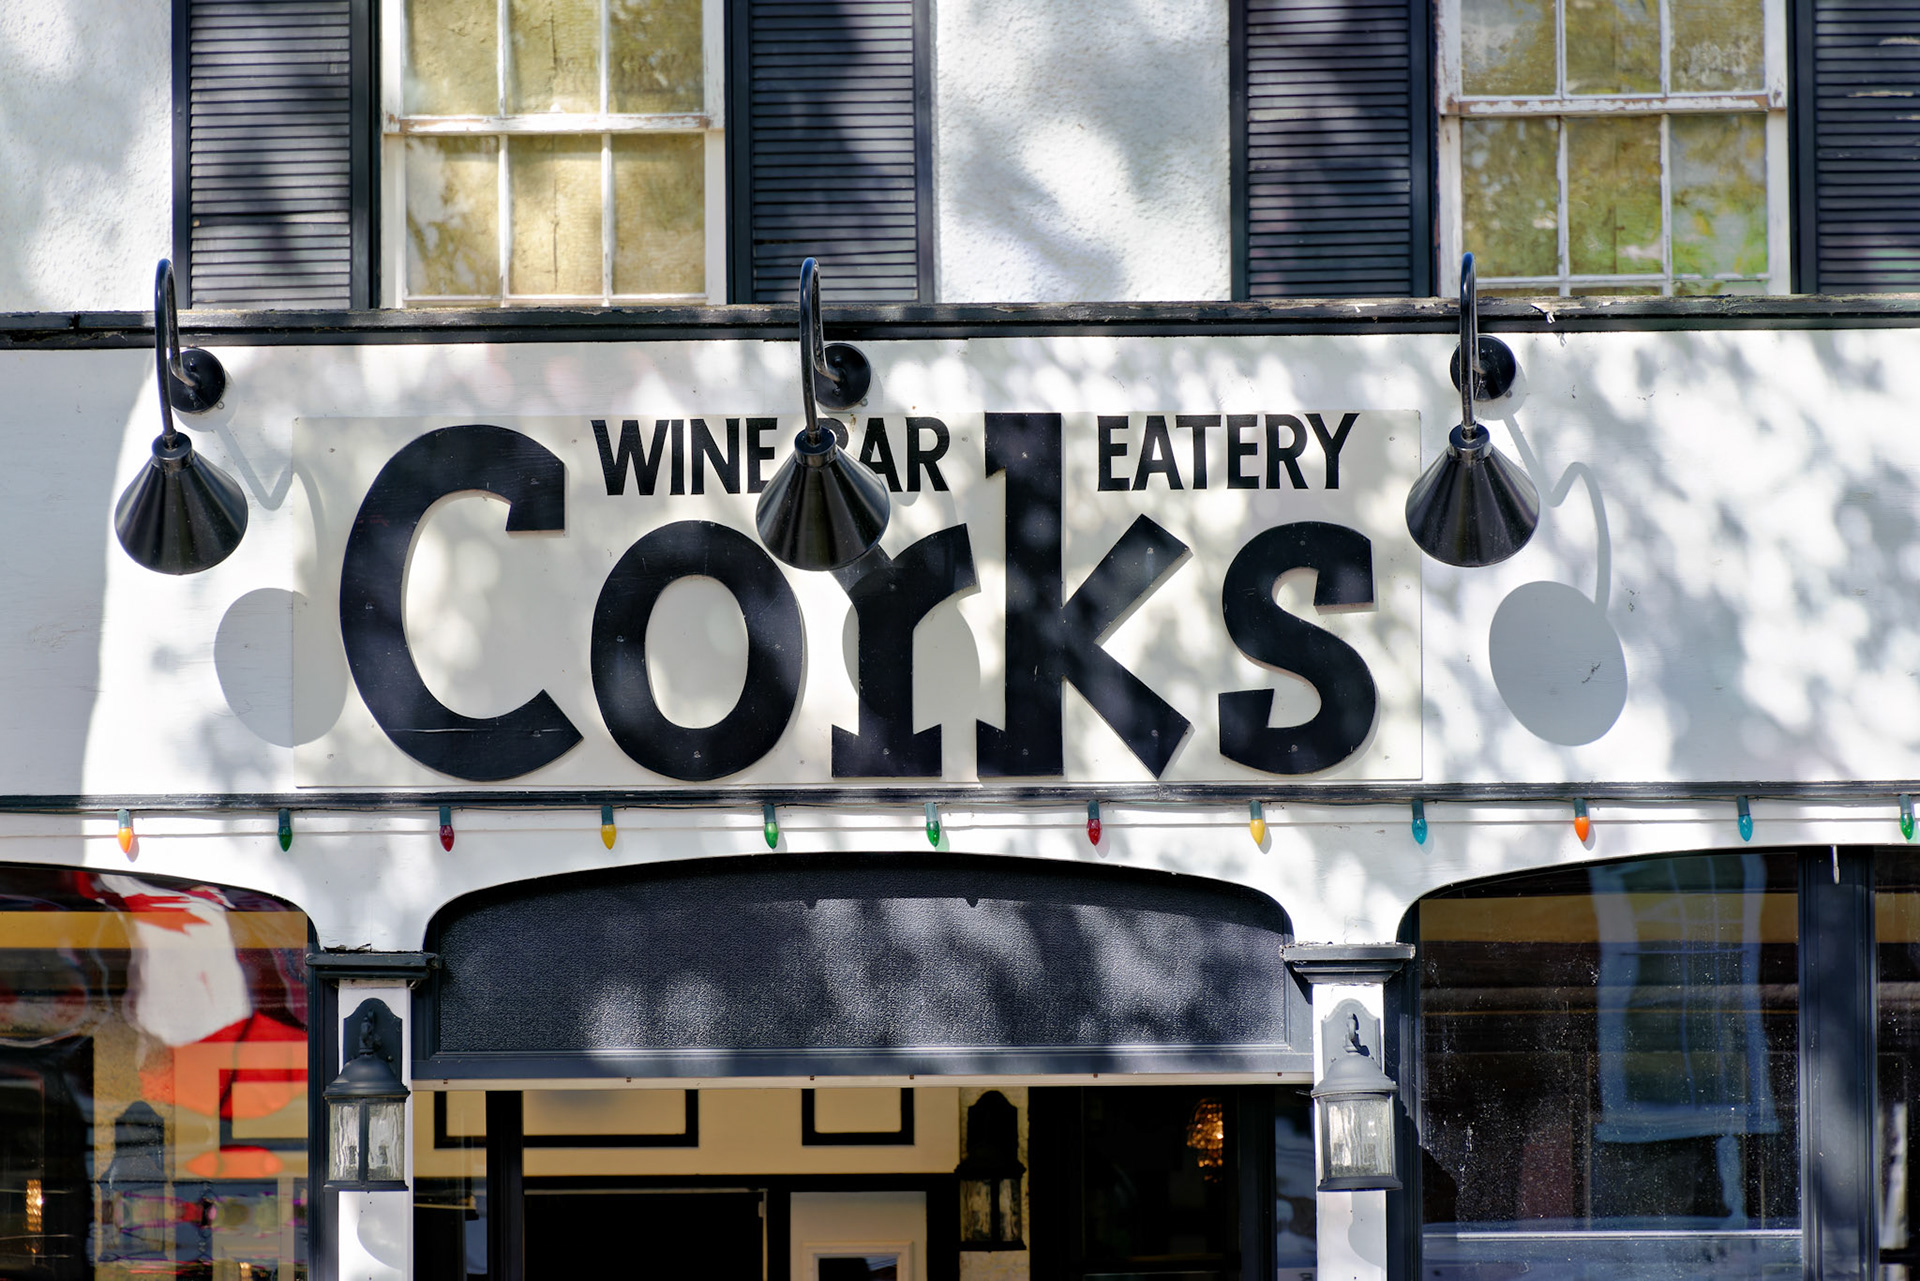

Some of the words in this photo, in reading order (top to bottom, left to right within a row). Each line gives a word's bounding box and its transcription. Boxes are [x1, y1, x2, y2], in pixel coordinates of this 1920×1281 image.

[591, 417, 778, 496] WINE
[1097, 412, 1360, 492] EATERY
[340, 412, 1377, 782] Corks
